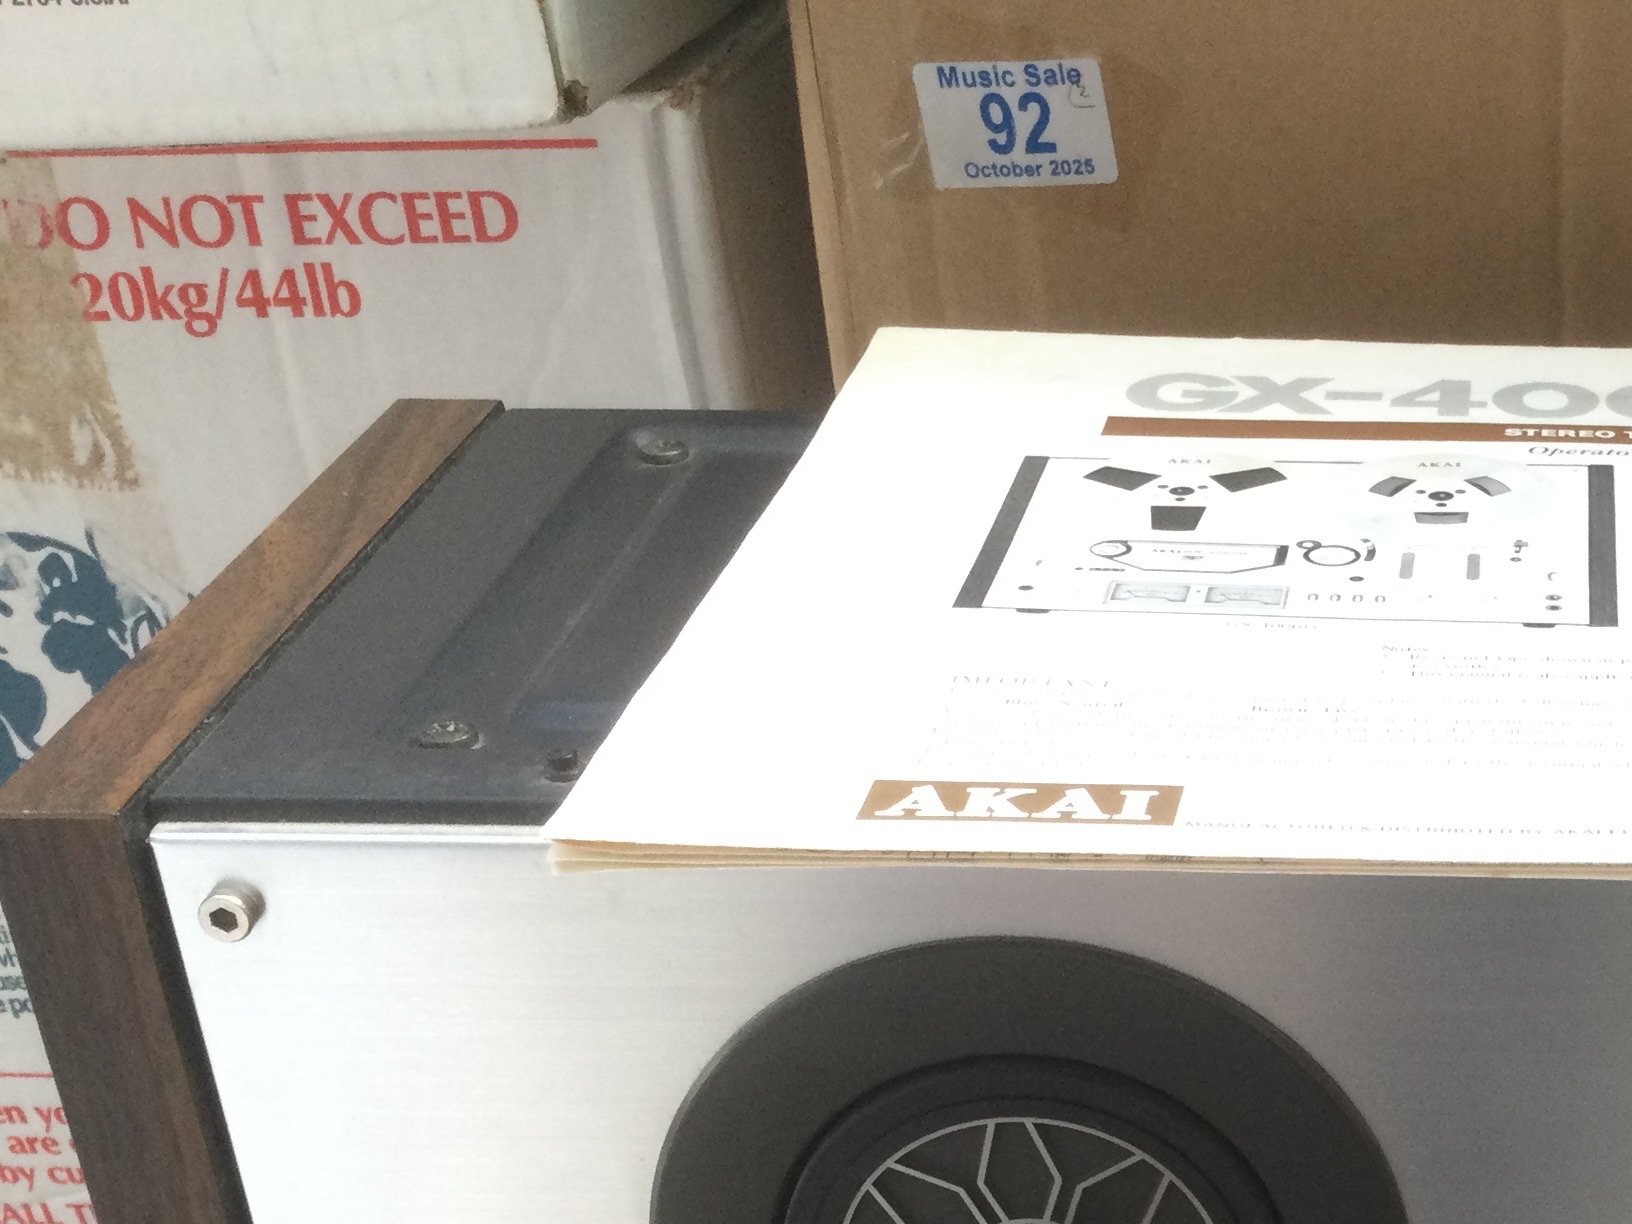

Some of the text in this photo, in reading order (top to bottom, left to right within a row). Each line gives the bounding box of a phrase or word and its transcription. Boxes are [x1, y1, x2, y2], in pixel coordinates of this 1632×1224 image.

[936, 63, 1081, 88] Music Sale
[980, 91, 1057, 155] 92
[965, 158, 1095, 178] October 2025
[127, 194, 264, 249] NOT
[284, 190, 519, 246] EXCEED
[70, 262, 362, 337] 20kg/44lb
[1504, 428, 1615, 439] STEREO
[874, 785, 1158, 820] AKAI
[7, 1136, 61, 1155] are
